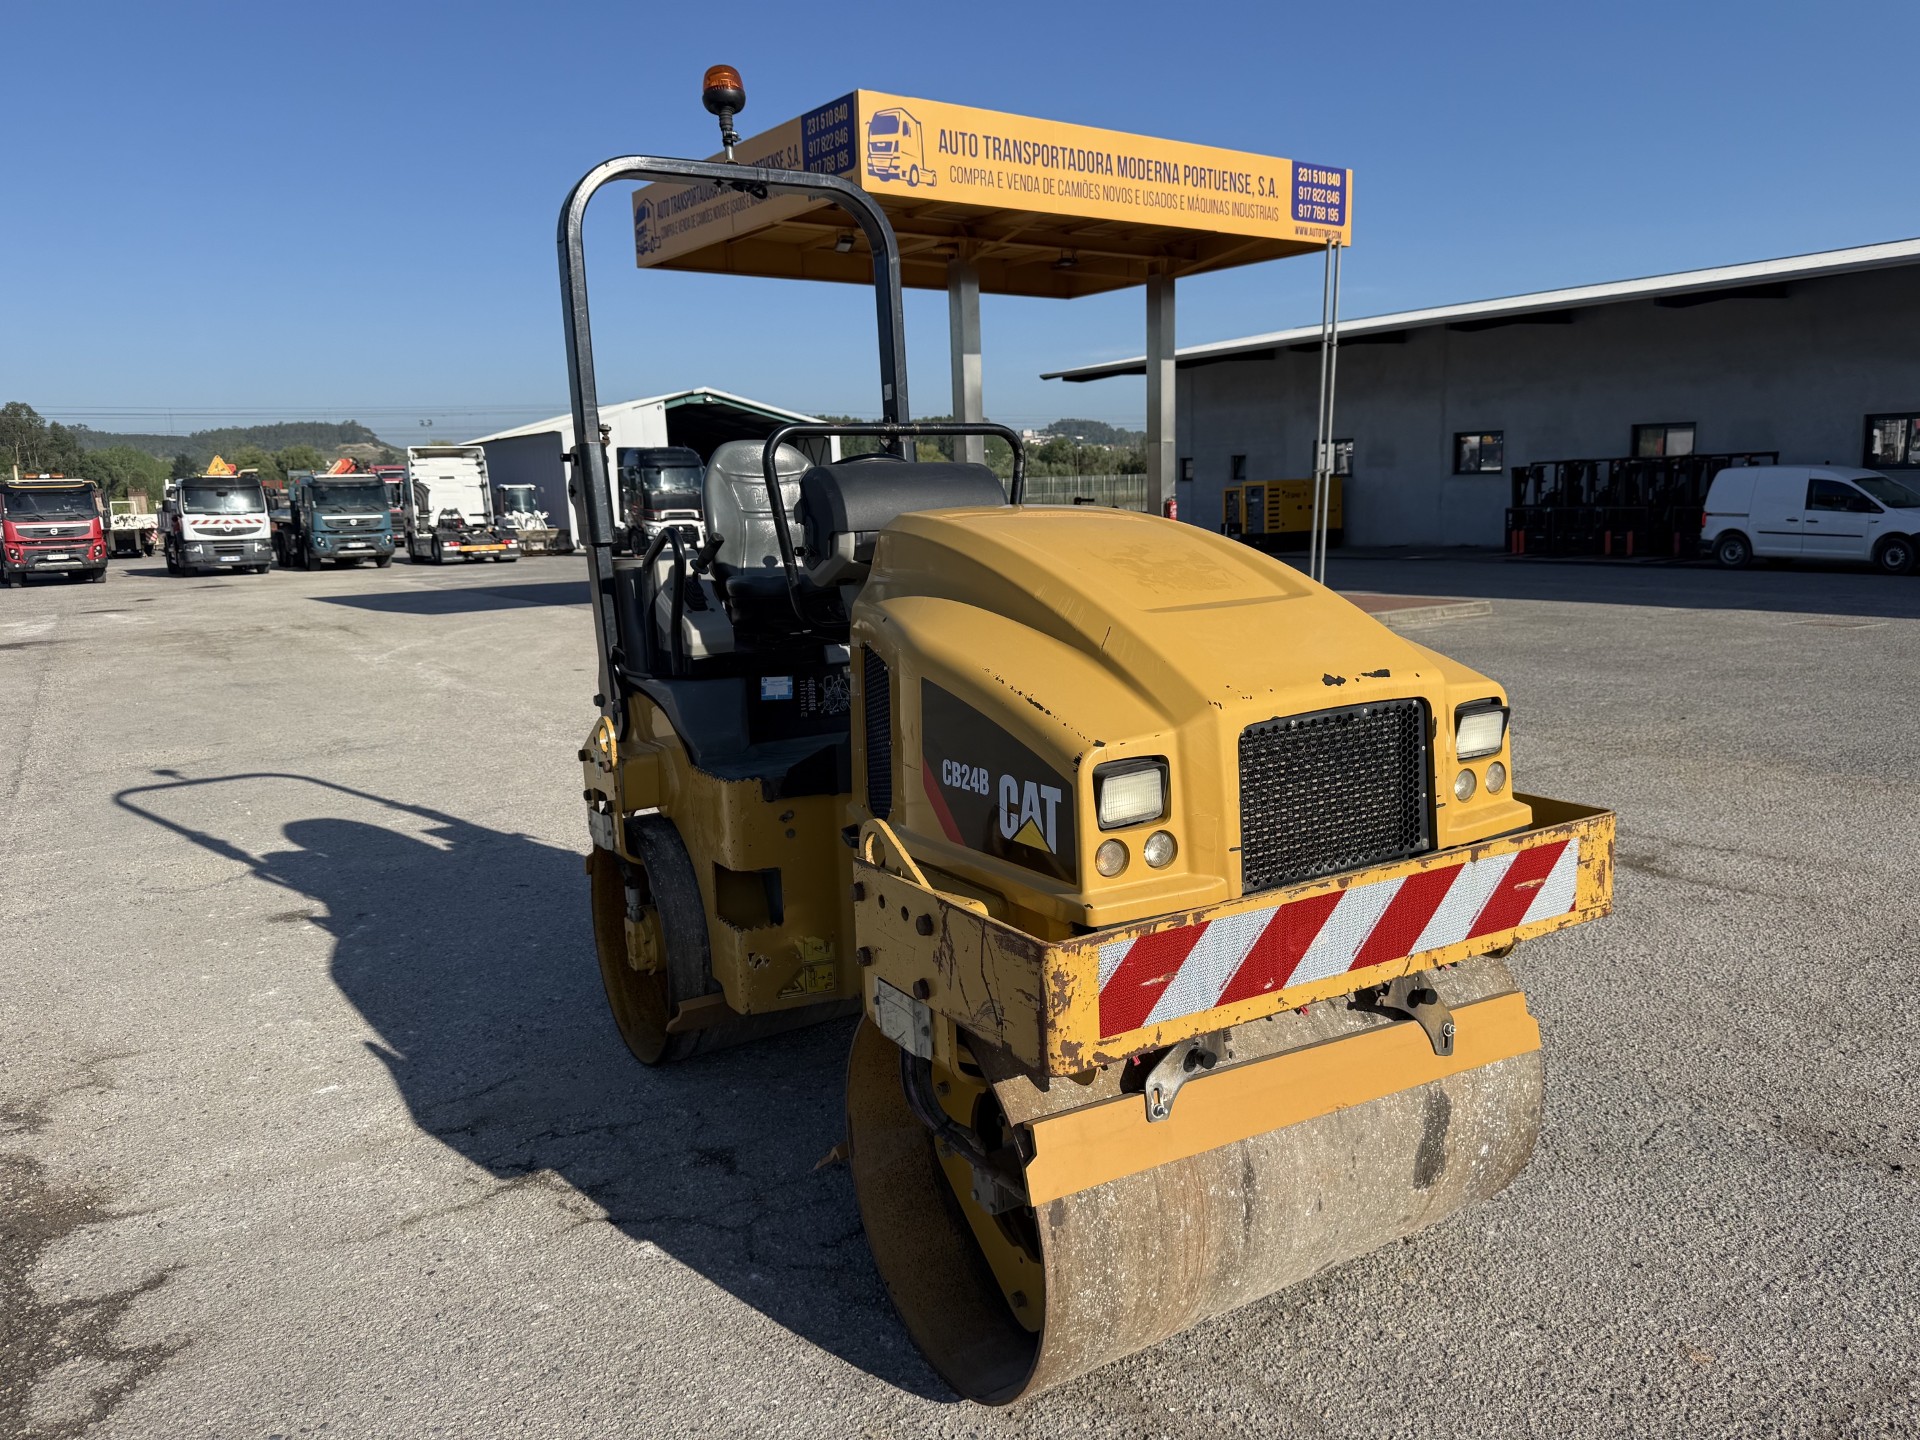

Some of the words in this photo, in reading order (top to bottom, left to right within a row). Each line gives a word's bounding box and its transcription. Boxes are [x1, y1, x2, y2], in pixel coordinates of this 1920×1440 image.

[807, 116, 819, 135] 231
[820, 109, 833, 129] 510
[834, 103, 848, 123] 840
[808, 138, 820, 158] 917
[821, 132, 834, 152] 822
[835, 127, 848, 147] 846
[823, 154, 835, 172] 768
[837, 149, 848, 169] 195
[938, 128, 978, 158] AUTO
[982, 135, 1114, 176] TRANSPORTADORA
[1117, 155, 1181, 185] MODERNA
[1184, 165, 1255, 198] PORTUENSE,
[1258, 175, 1279, 199] S.A.
[1298, 167, 1312, 183] 231
[1313, 169, 1326, 185] 510
[1327, 172, 1341, 187] 840
[950, 165, 995, 188] COMPRA
[998, 171, 1003, 189] E
[1006, 172, 1041, 194] VENDA
[1043, 177, 1055, 195] DE
[1057, 179, 1100, 201] CAMIÕES
[1102, 184, 1133, 205] NOVOS
[1135, 189, 1141, 206] E
[1143, 190, 1178, 210] USADOS
[1180, 194, 1185, 211] E
[1187, 194, 1230, 216] MÁQUINAS
[1232, 201, 1279, 222] INDUSTRIAIS
[1298, 185, 1312, 201] 917
[1312, 188, 1326, 203] 822
[1327, 190, 1340, 205] 846
[1298, 203, 1312, 218] 917
[1313, 205, 1326, 220] 768
[1327, 208, 1339, 222] 195
[942, 759, 990, 796] CB24B
[998, 774, 1062, 855] CAT
